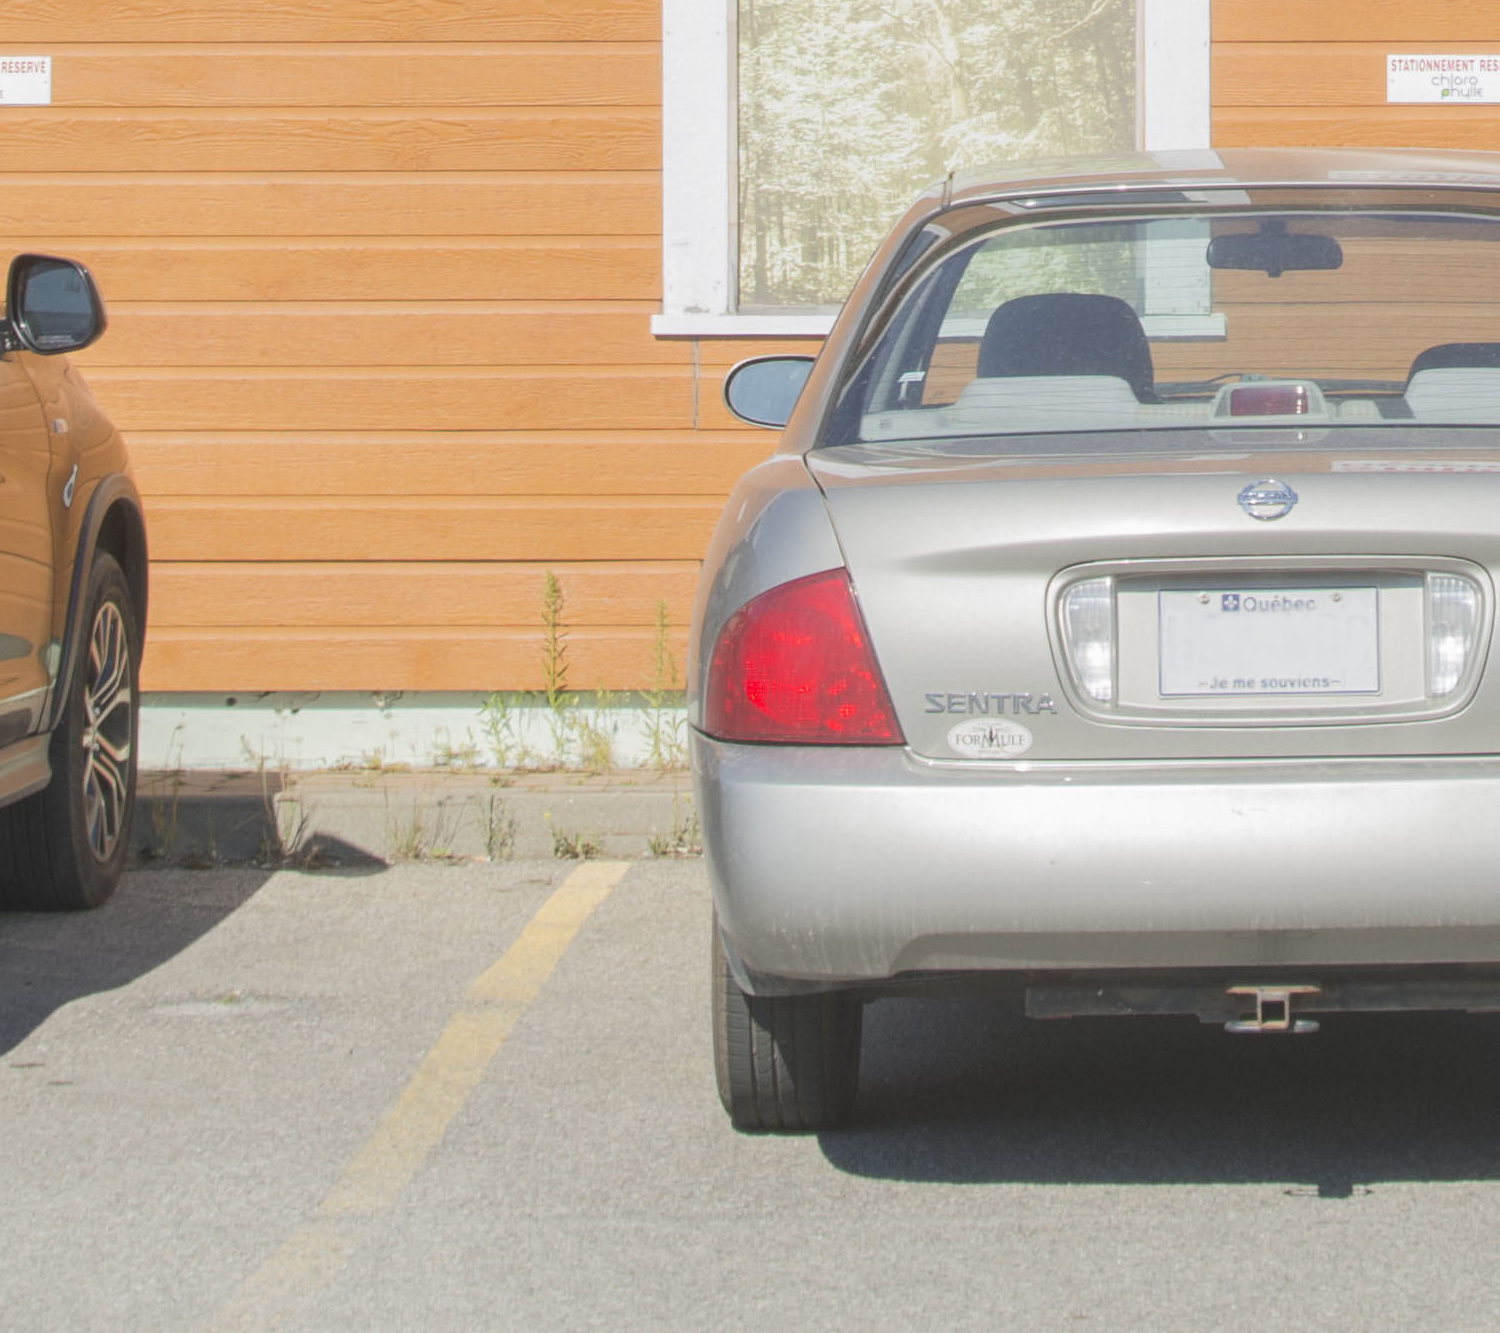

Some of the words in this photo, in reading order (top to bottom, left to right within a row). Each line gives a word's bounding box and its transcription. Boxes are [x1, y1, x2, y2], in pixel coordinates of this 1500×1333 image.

[1391, 59, 1475, 72] STATIONNEMENT
[1243, 594, 1317, 613] Québec
[1232, 677, 1256, 689] me
[924, 692, 1058, 715] SENTRA
